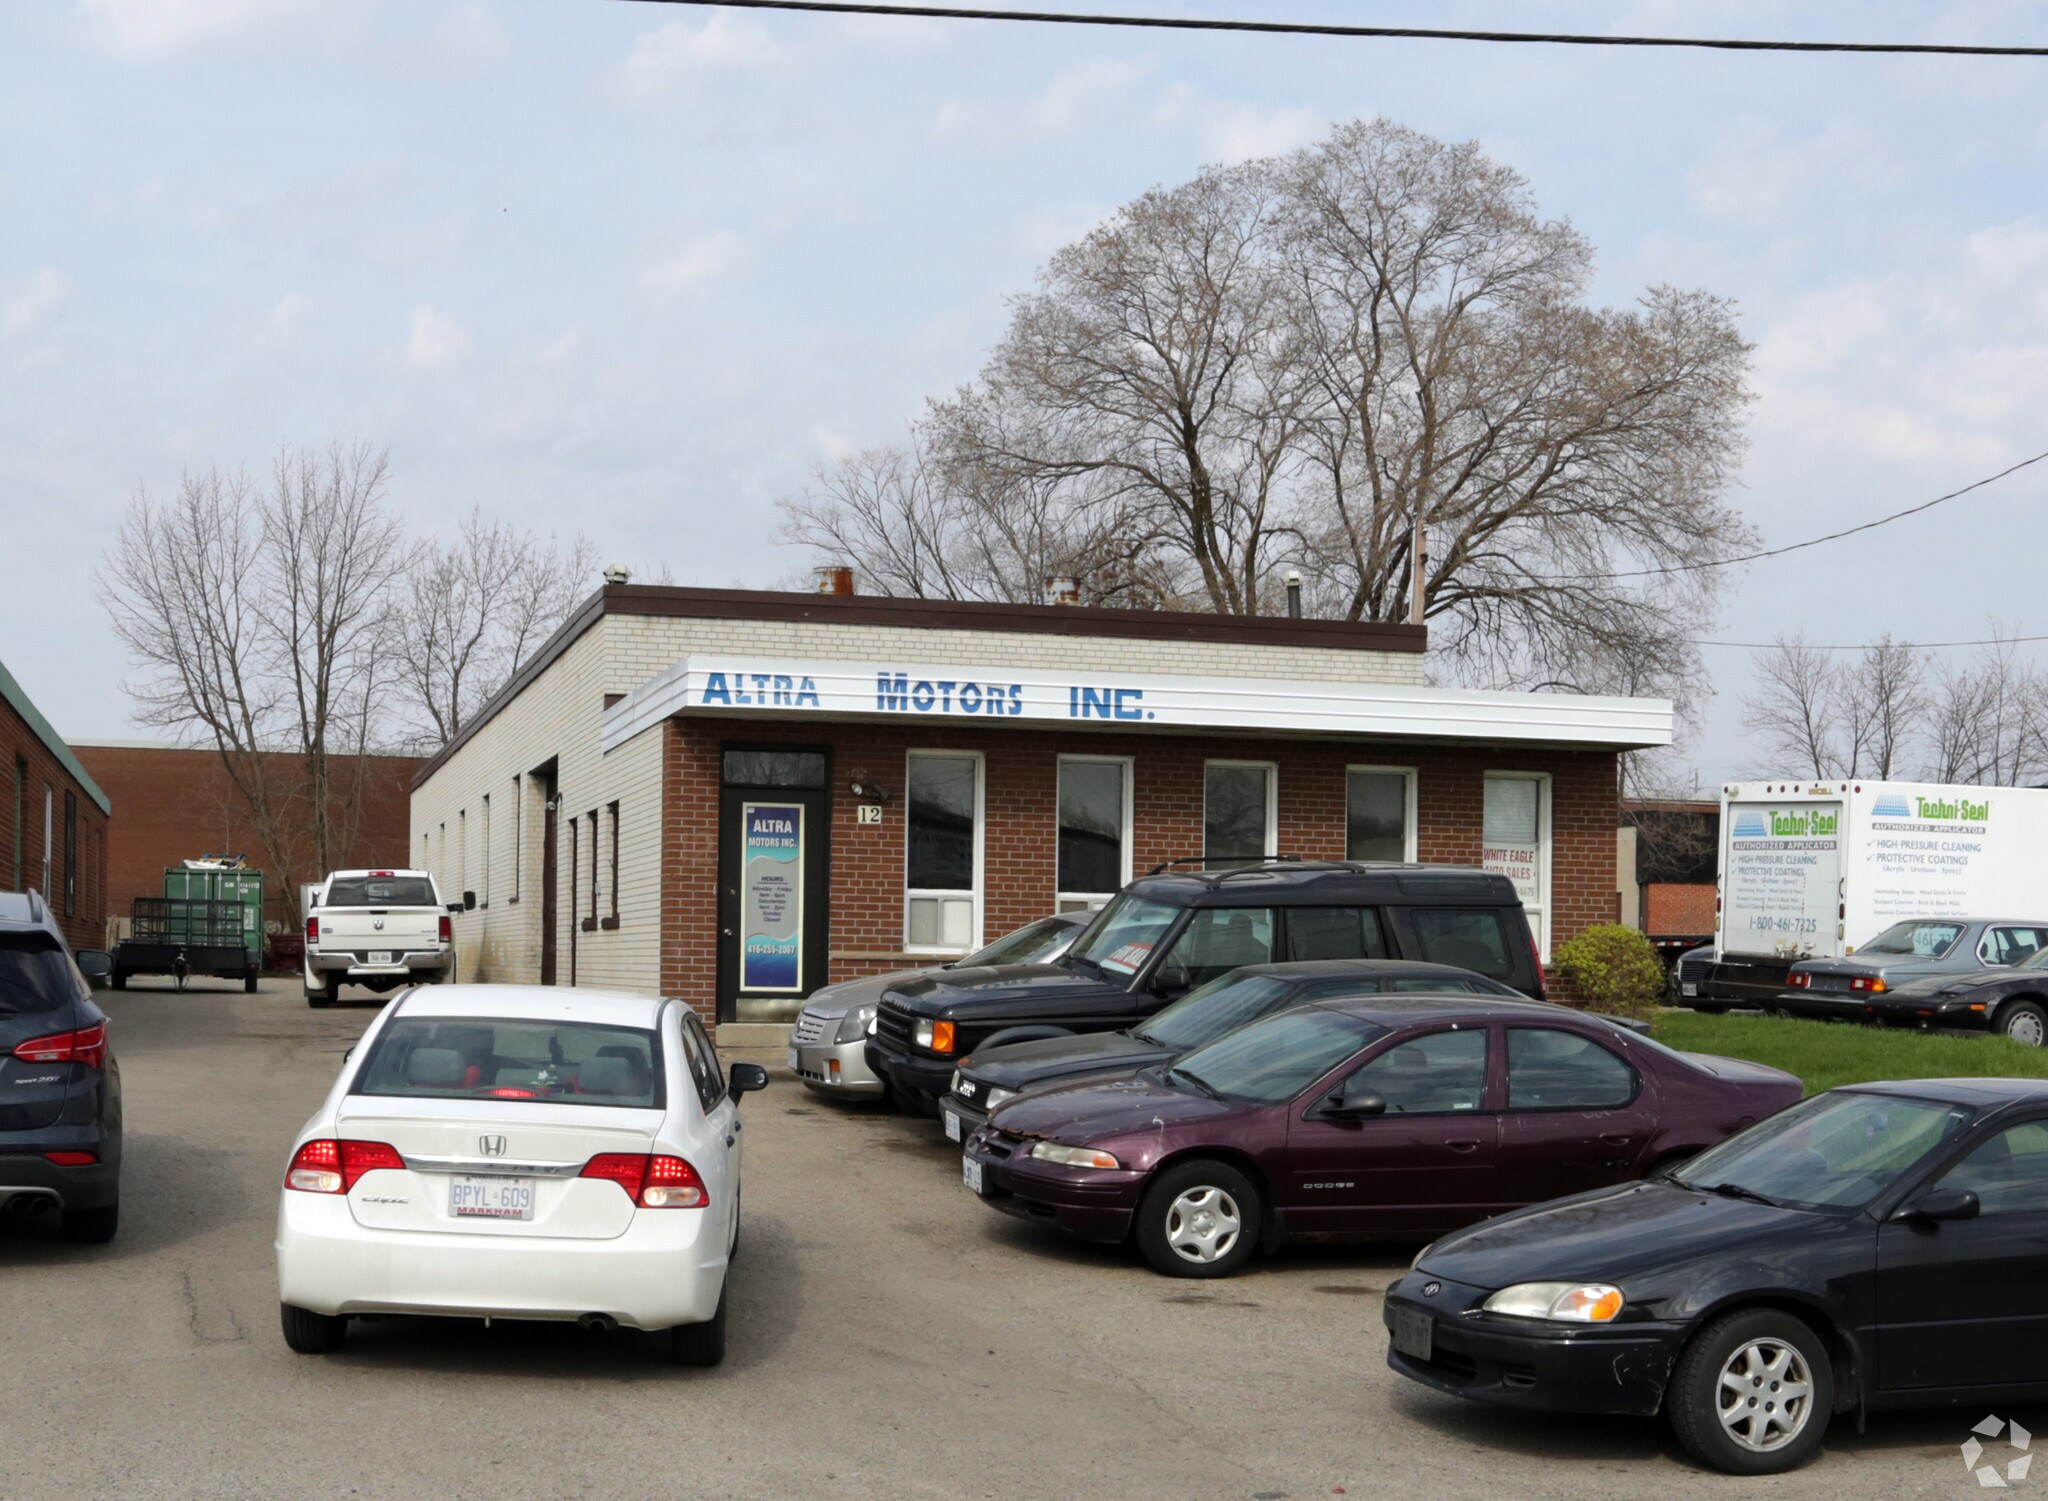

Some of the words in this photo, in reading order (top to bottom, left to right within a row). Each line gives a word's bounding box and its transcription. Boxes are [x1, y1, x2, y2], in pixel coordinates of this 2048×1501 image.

[702, 672, 820, 706] ALTRA
[877, 672, 1023, 716] MOTORS
[1070, 687, 1155, 720] INC.
[860, 807, 880, 822] 12
[753, 819, 793, 833] ALTRA
[1874, 823, 1930, 832] AUTHORIZED
[1934, 825, 1984, 834] APPLICATOR
[748, 837, 780, 847] MOTORS
[781, 838, 797, 848] INC.
[1734, 842, 1784, 850] AUTHORIZED
[1787, 841, 1835, 849] APPLICATOR
[1941, 842, 1982, 852] CLEANING
[1483, 848, 1508, 862] WHITE
[1510, 849, 1534, 863] EAGLE
[1786, 856, 1817, 865] CLEANING
[1876, 853, 1925, 863] PROTECTIVE
[1928, 854, 1968, 865] COATINGS
[1506, 866, 1531, 880] SALES
[1738, 867, 1772, 876] PROTECTIVE
[1774, 867, 1804, 876] COATINGS
[1749, 916, 1817, 932] 1-800-461-7325
[453, 1184, 490, 1206] BPYL
[501, 1187, 529, 1207] 609
[457, 1207, 523, 1216] MARKHAM
